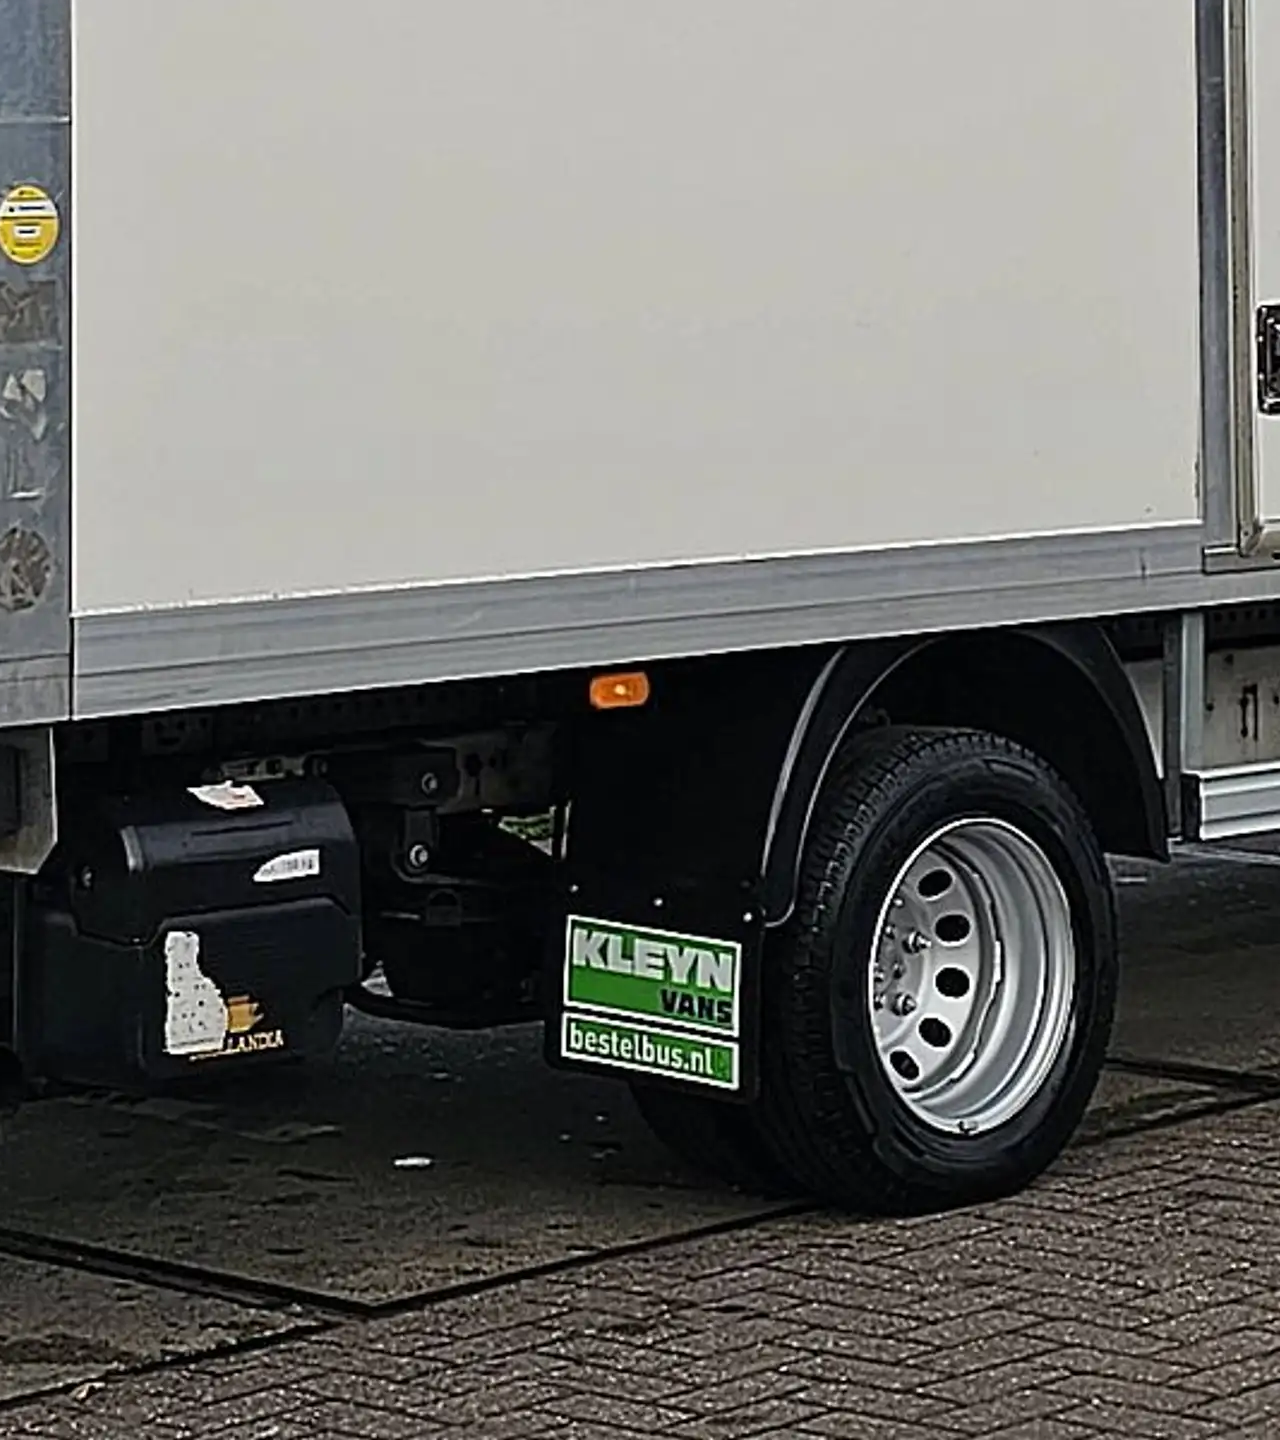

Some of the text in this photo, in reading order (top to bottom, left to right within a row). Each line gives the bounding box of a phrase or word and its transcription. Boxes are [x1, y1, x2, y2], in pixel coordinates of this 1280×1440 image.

[572, 927, 733, 993] KLEYN
[660, 988, 733, 1025] VANS
[570, 1021, 714, 1076] bestelbus.nl
